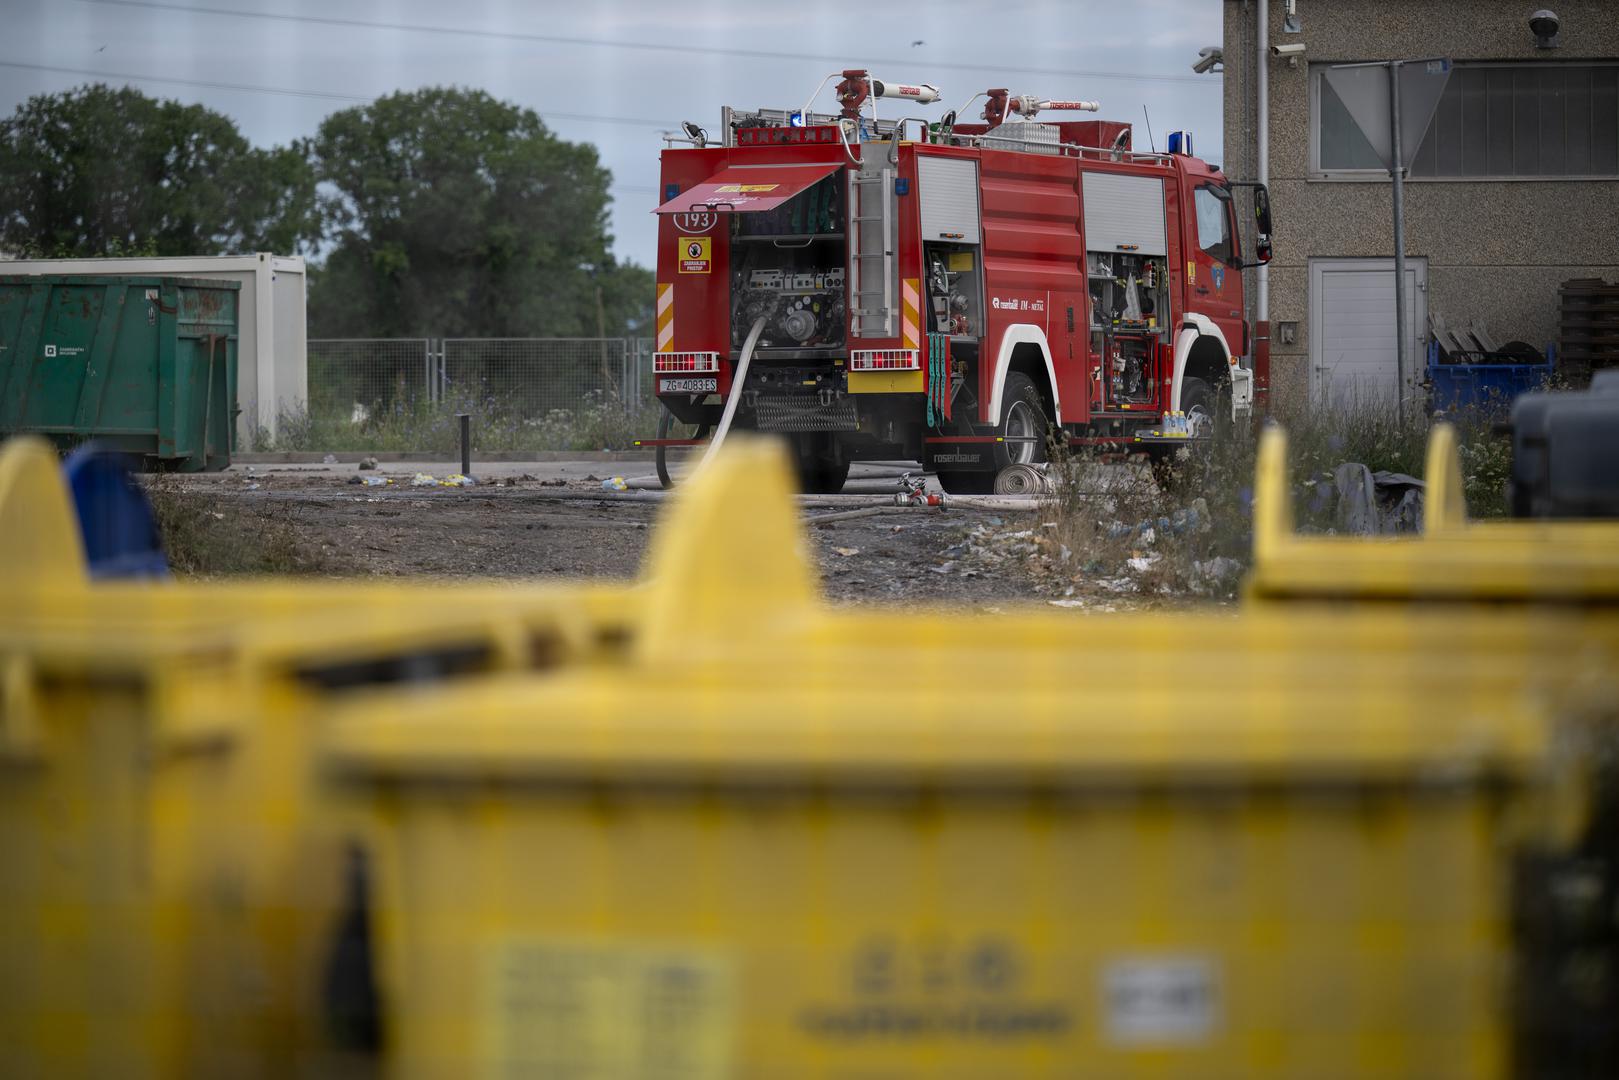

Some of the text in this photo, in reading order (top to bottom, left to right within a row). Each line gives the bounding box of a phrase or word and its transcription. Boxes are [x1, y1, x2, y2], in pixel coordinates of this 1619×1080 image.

[1050, 102, 1082, 110] rosenbauer
[681, 213, 709, 227] 193
[666, 380, 677, 391] ZG
[933, 450, 981, 463] rosenbauer
